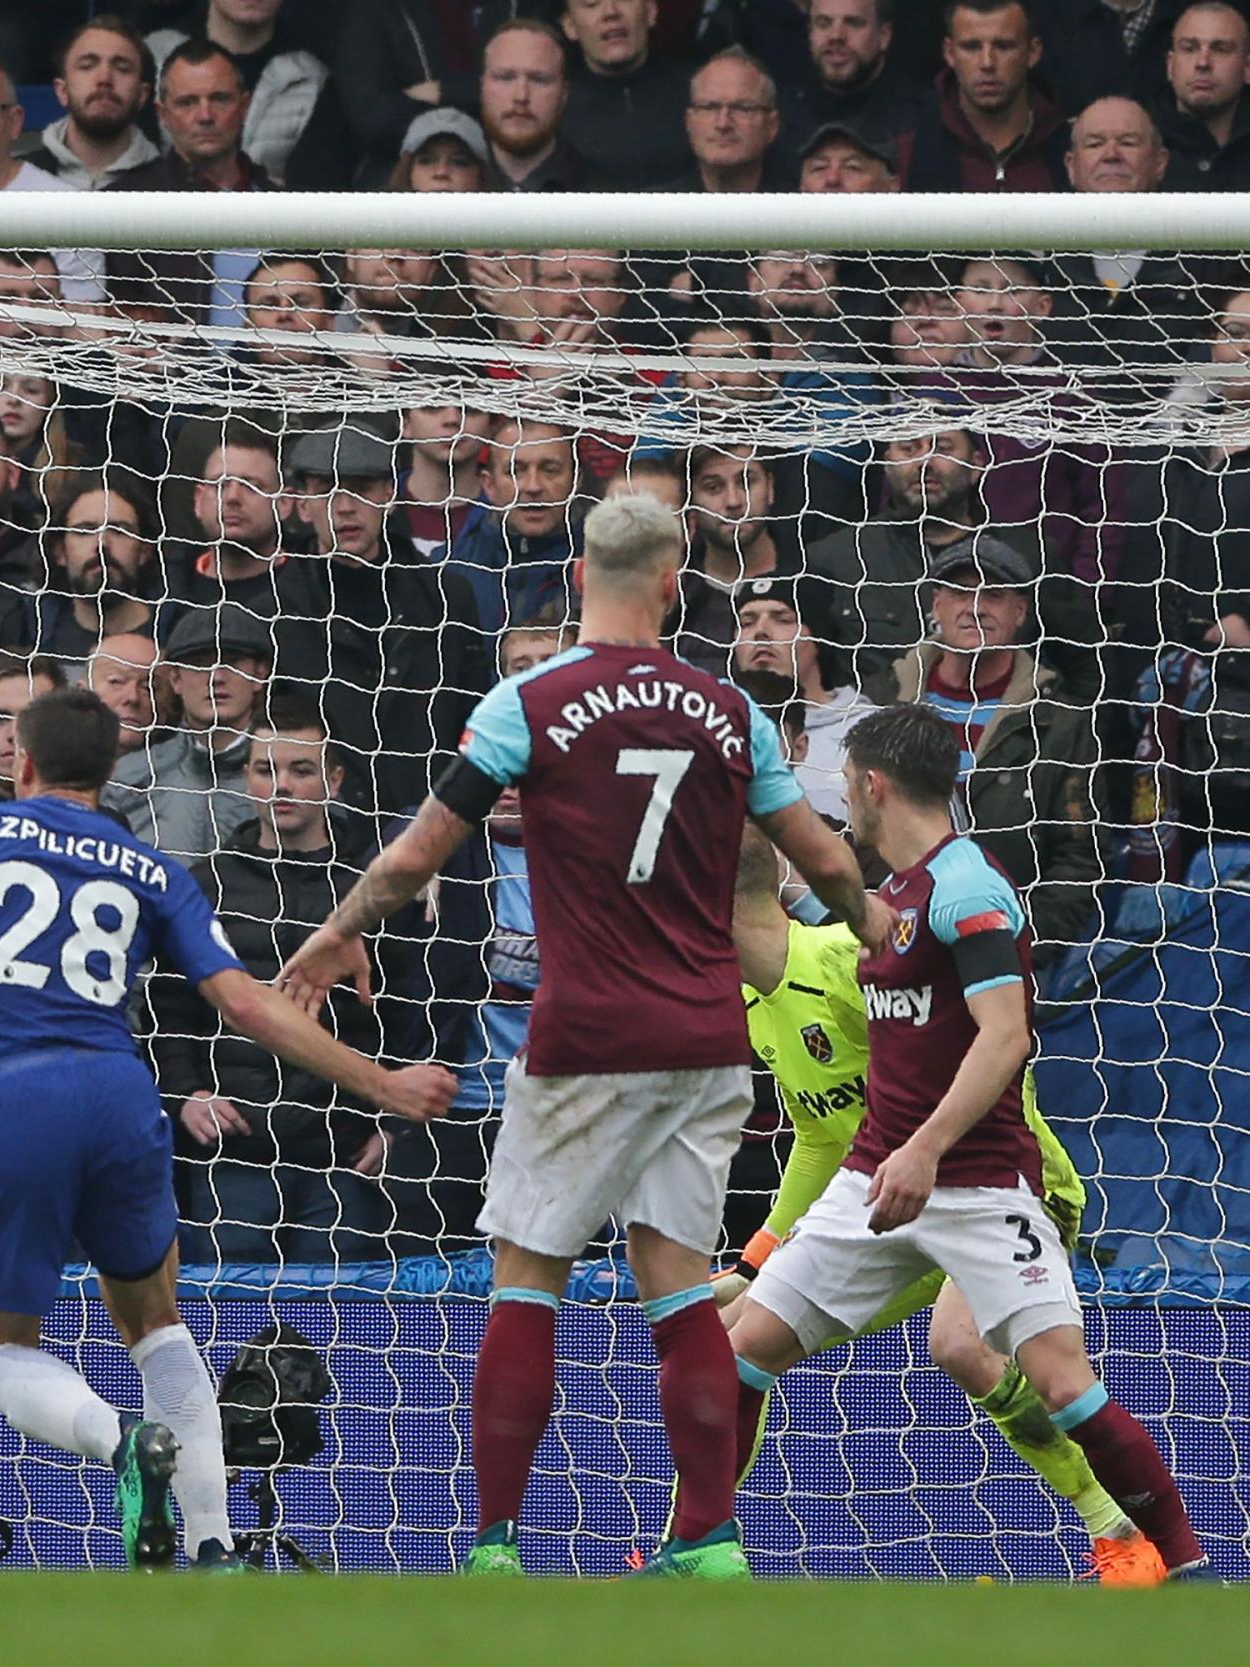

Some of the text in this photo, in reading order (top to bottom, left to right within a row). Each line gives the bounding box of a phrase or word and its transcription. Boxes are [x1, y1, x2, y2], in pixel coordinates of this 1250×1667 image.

[546, 681, 745, 759] ARNAUTOVIĆ
[616, 748, 695, 884] 7
[1005, 1214, 1042, 1262] 3
